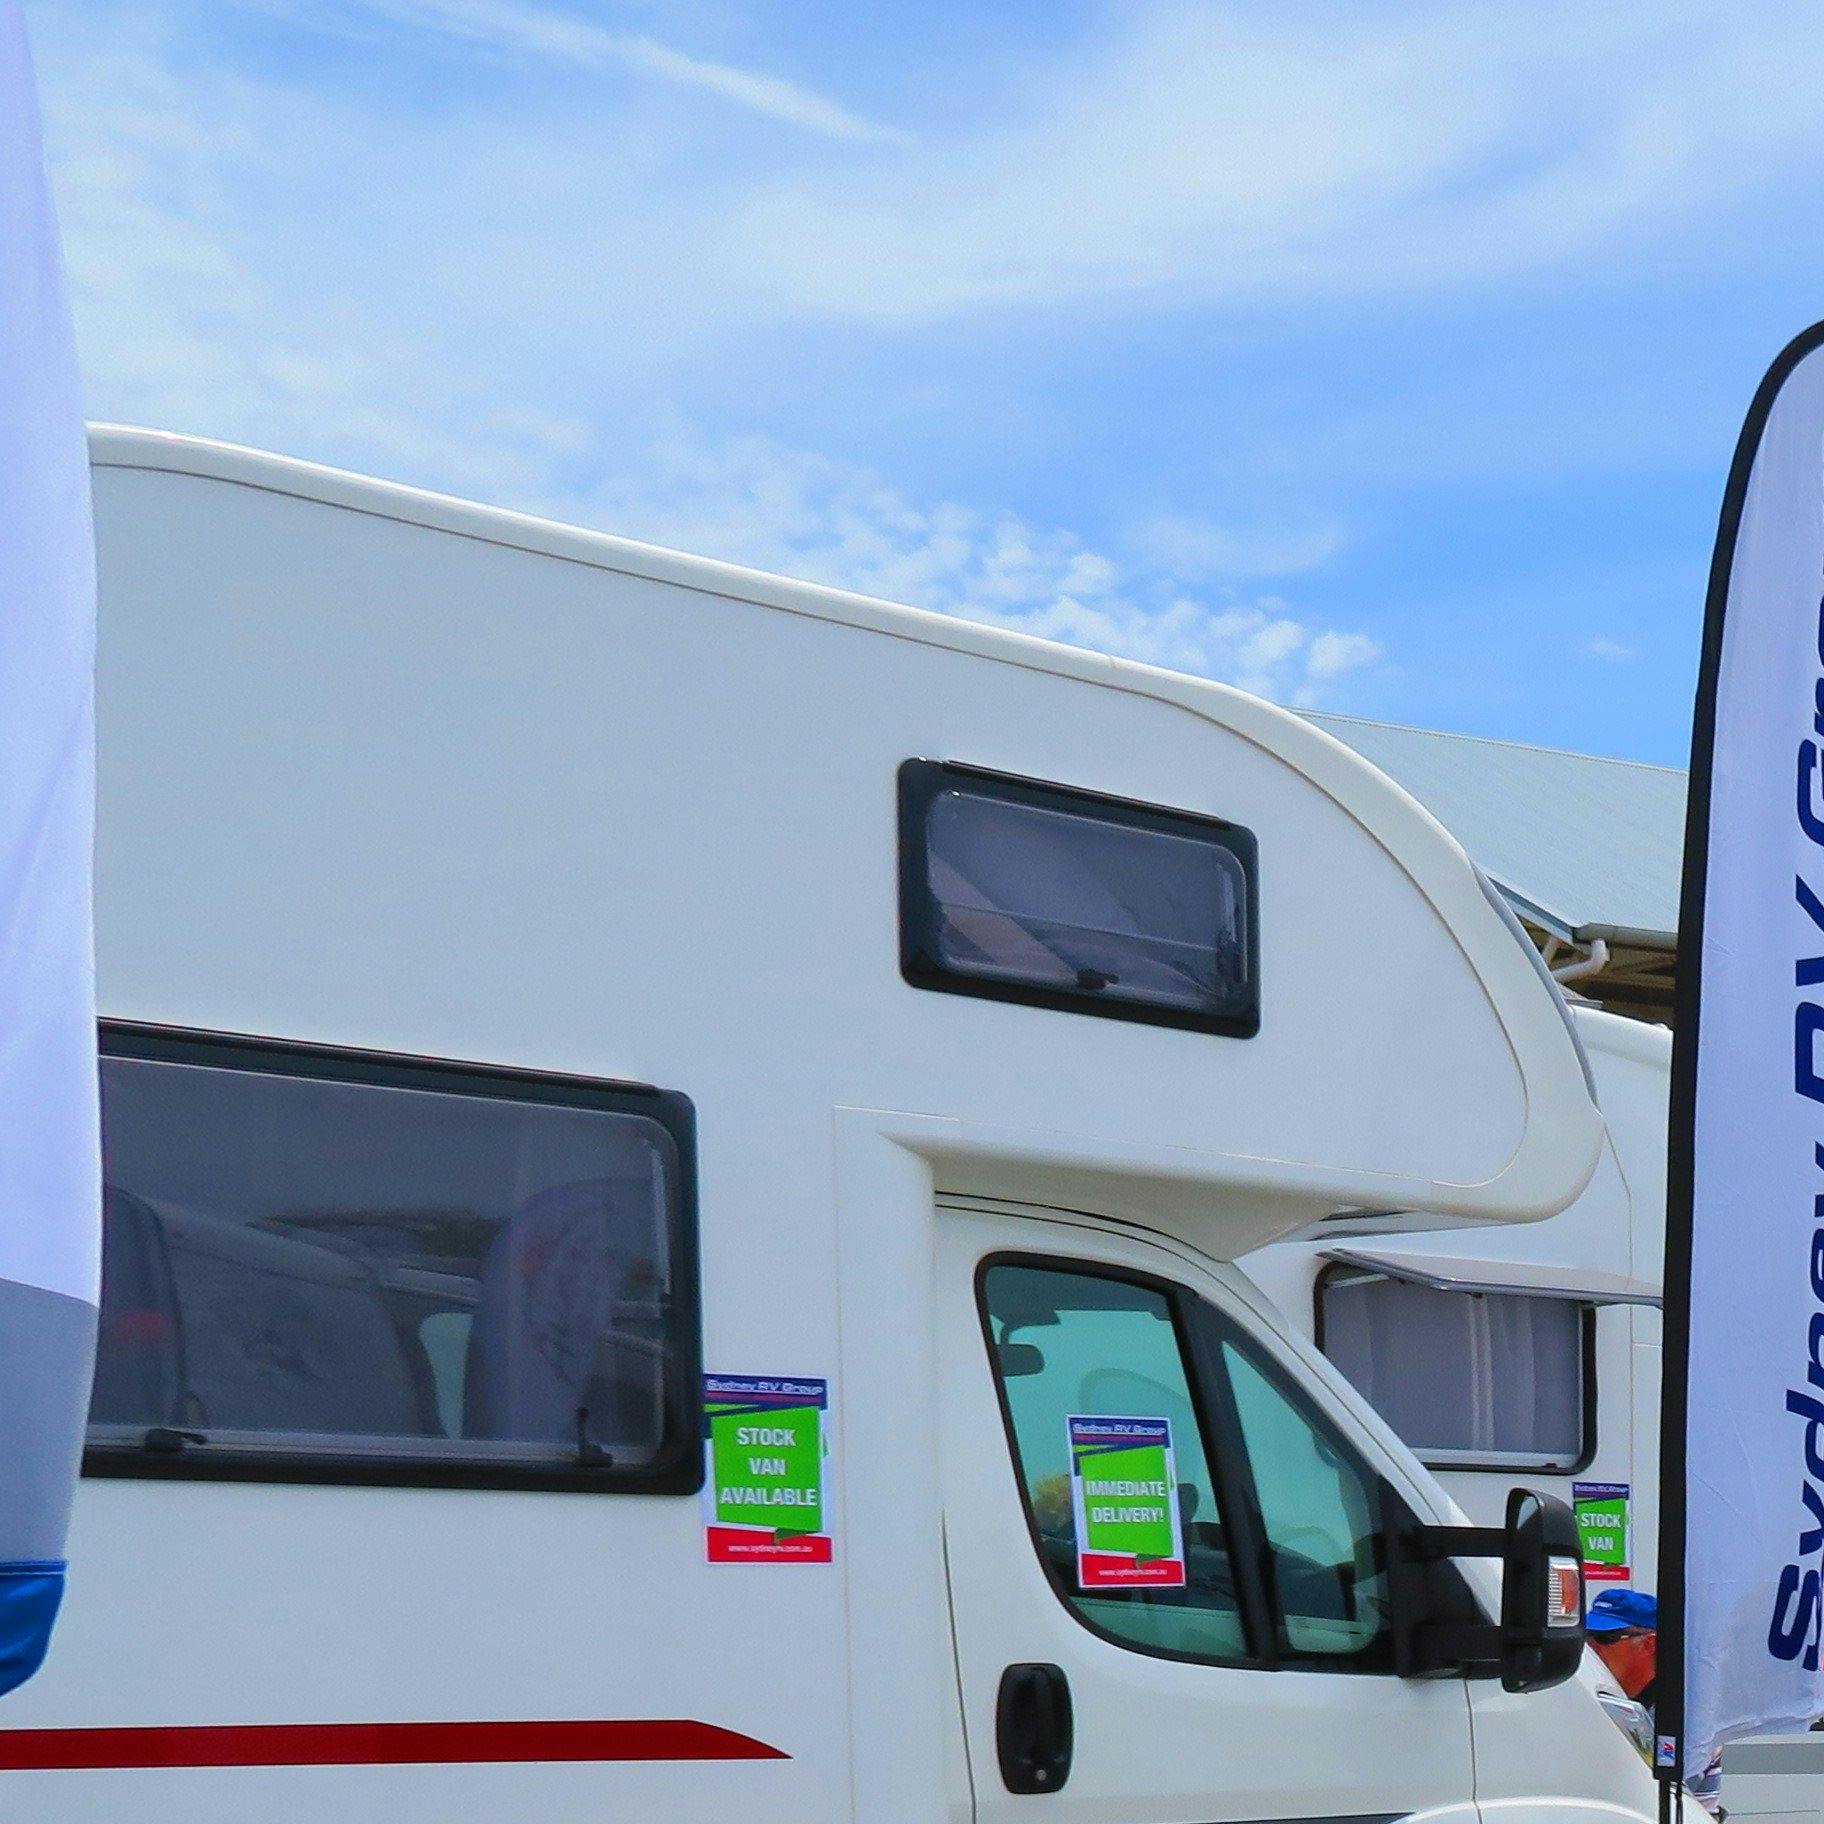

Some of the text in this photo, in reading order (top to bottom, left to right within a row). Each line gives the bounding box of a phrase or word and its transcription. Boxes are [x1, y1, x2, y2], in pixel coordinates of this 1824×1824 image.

[758, 1382, 780, 1392] RV
[736, 1427, 797, 1447] STOCK
[748, 1457, 787, 1476] VAN
[719, 1487, 818, 1507] AVAILABLE
[1085, 1480, 1167, 1497] IMMEDIATE
[1091, 1506, 1165, 1523] DELIVERY!
[1581, 1512, 1622, 1529] STOCK
[1588, 1536, 1615, 1552] VAN
